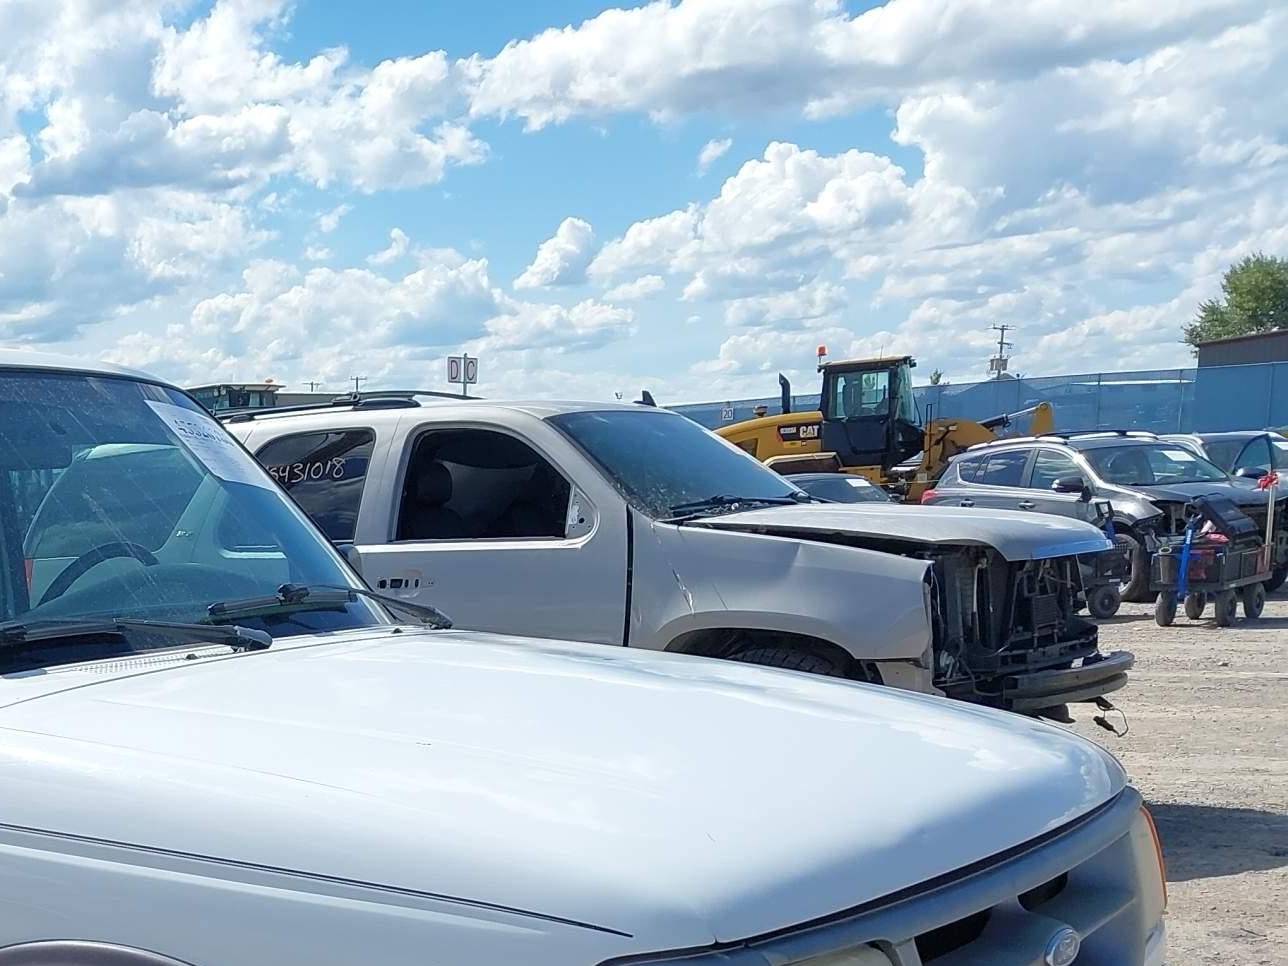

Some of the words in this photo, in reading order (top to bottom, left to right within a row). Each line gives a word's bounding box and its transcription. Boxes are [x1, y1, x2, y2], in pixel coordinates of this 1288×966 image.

[450, 359, 459, 380] D
[466, 360, 475, 381] C
[723, 408, 733, 419] 20
[799, 425, 820, 438] CAT
